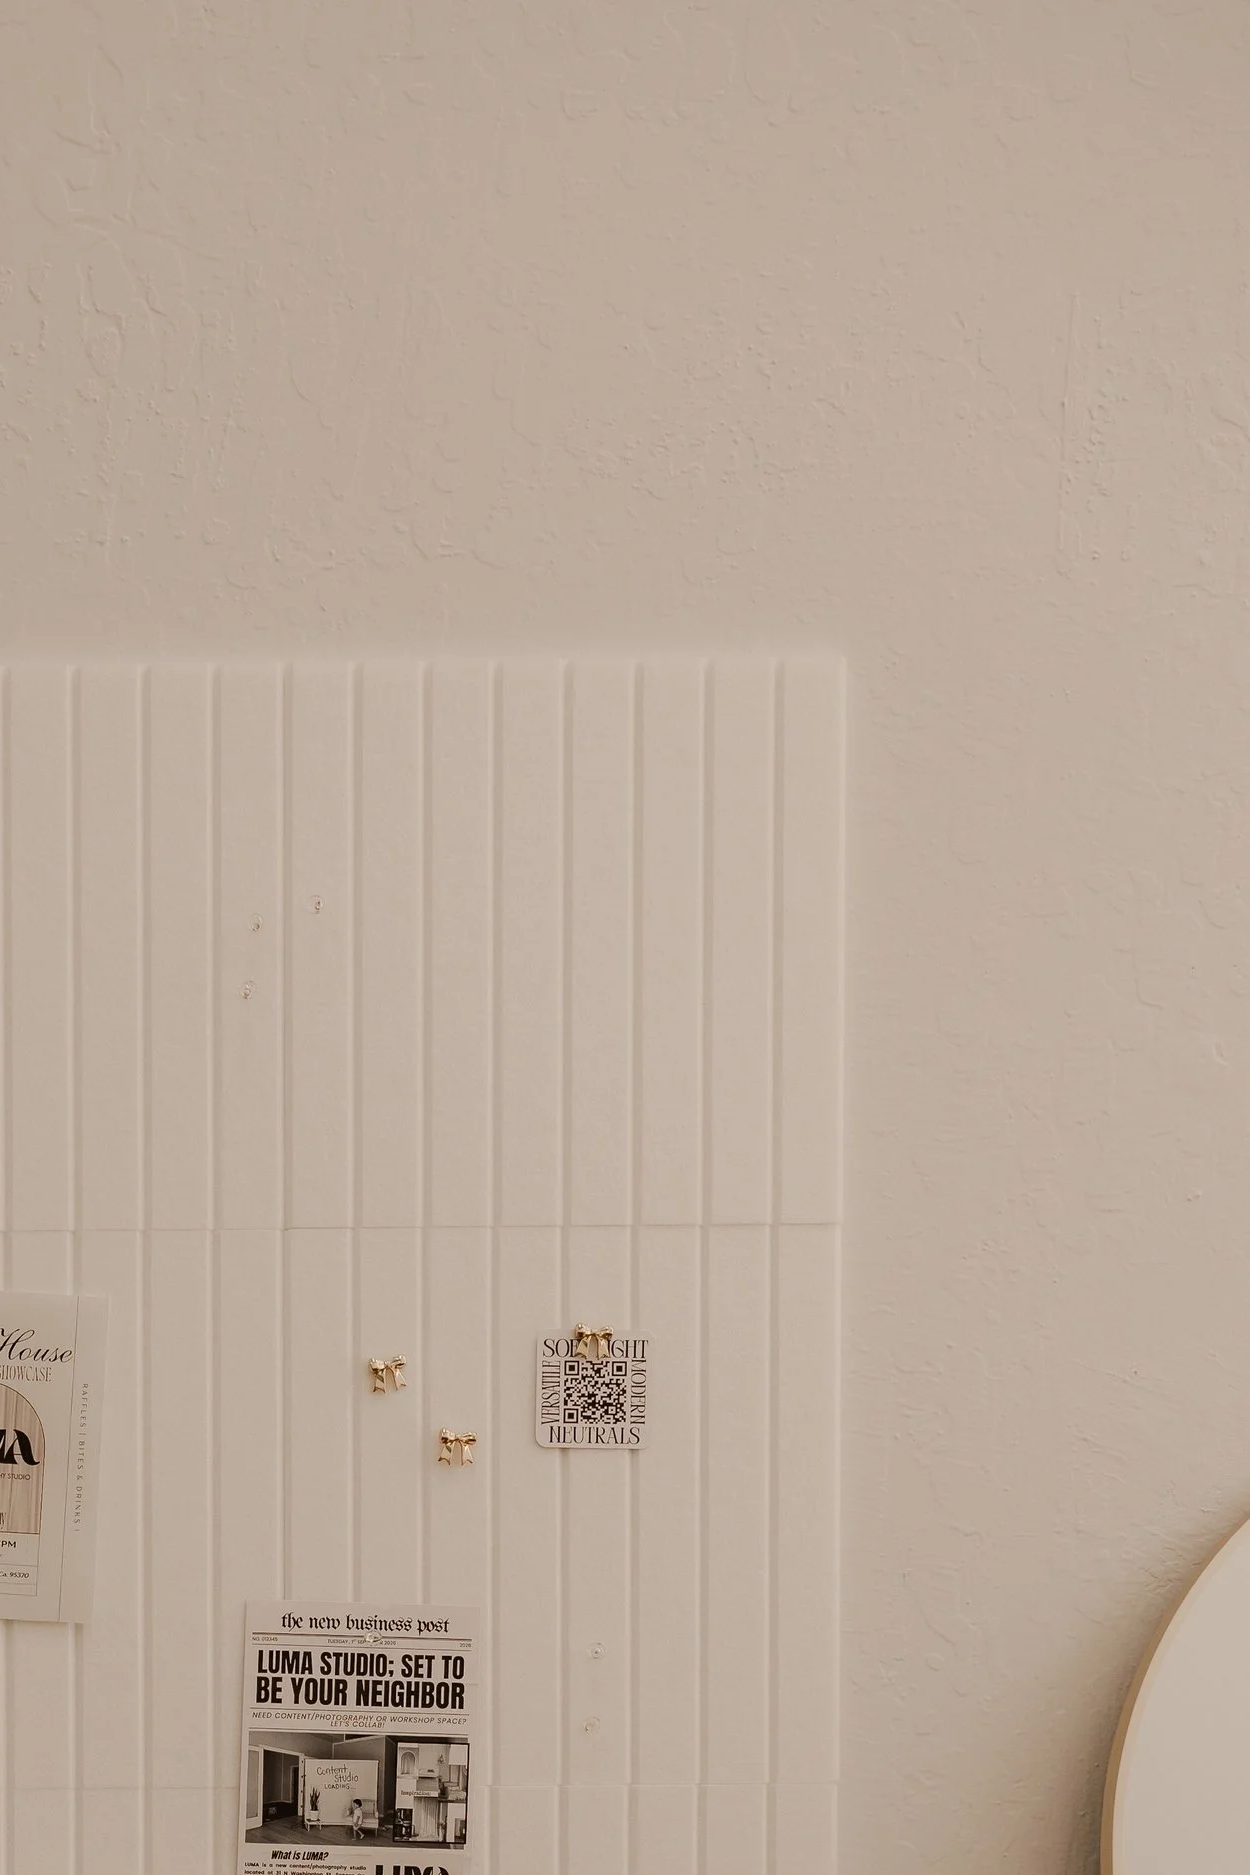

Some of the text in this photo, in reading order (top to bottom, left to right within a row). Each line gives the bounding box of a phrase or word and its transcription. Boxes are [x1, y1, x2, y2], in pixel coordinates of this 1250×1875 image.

[604, 1339, 648, 1358] IGHT
[541, 1360, 560, 1424] VERSATILE
[630, 1360, 647, 1425] MODERN
[80, 1384, 88, 1427] RAFFLES
[550, 1426, 640, 1444] NEUTRALS
[74, 1486, 82, 1524] DRINKS
[282, 1612, 449, 1636] the new business post
[258, 1650, 465, 1679] LUMA STUDIO; SET TO
[256, 1677, 465, 1709] BE YOUR NEIGHBOR
[275, 1713, 374, 1722] CONTENT/PHOTOGRAPHY
[316, 1764, 348, 1776] Content
[334, 1774, 358, 1782] Studio
[271, 1850, 329, 1860] What is LUMA?
